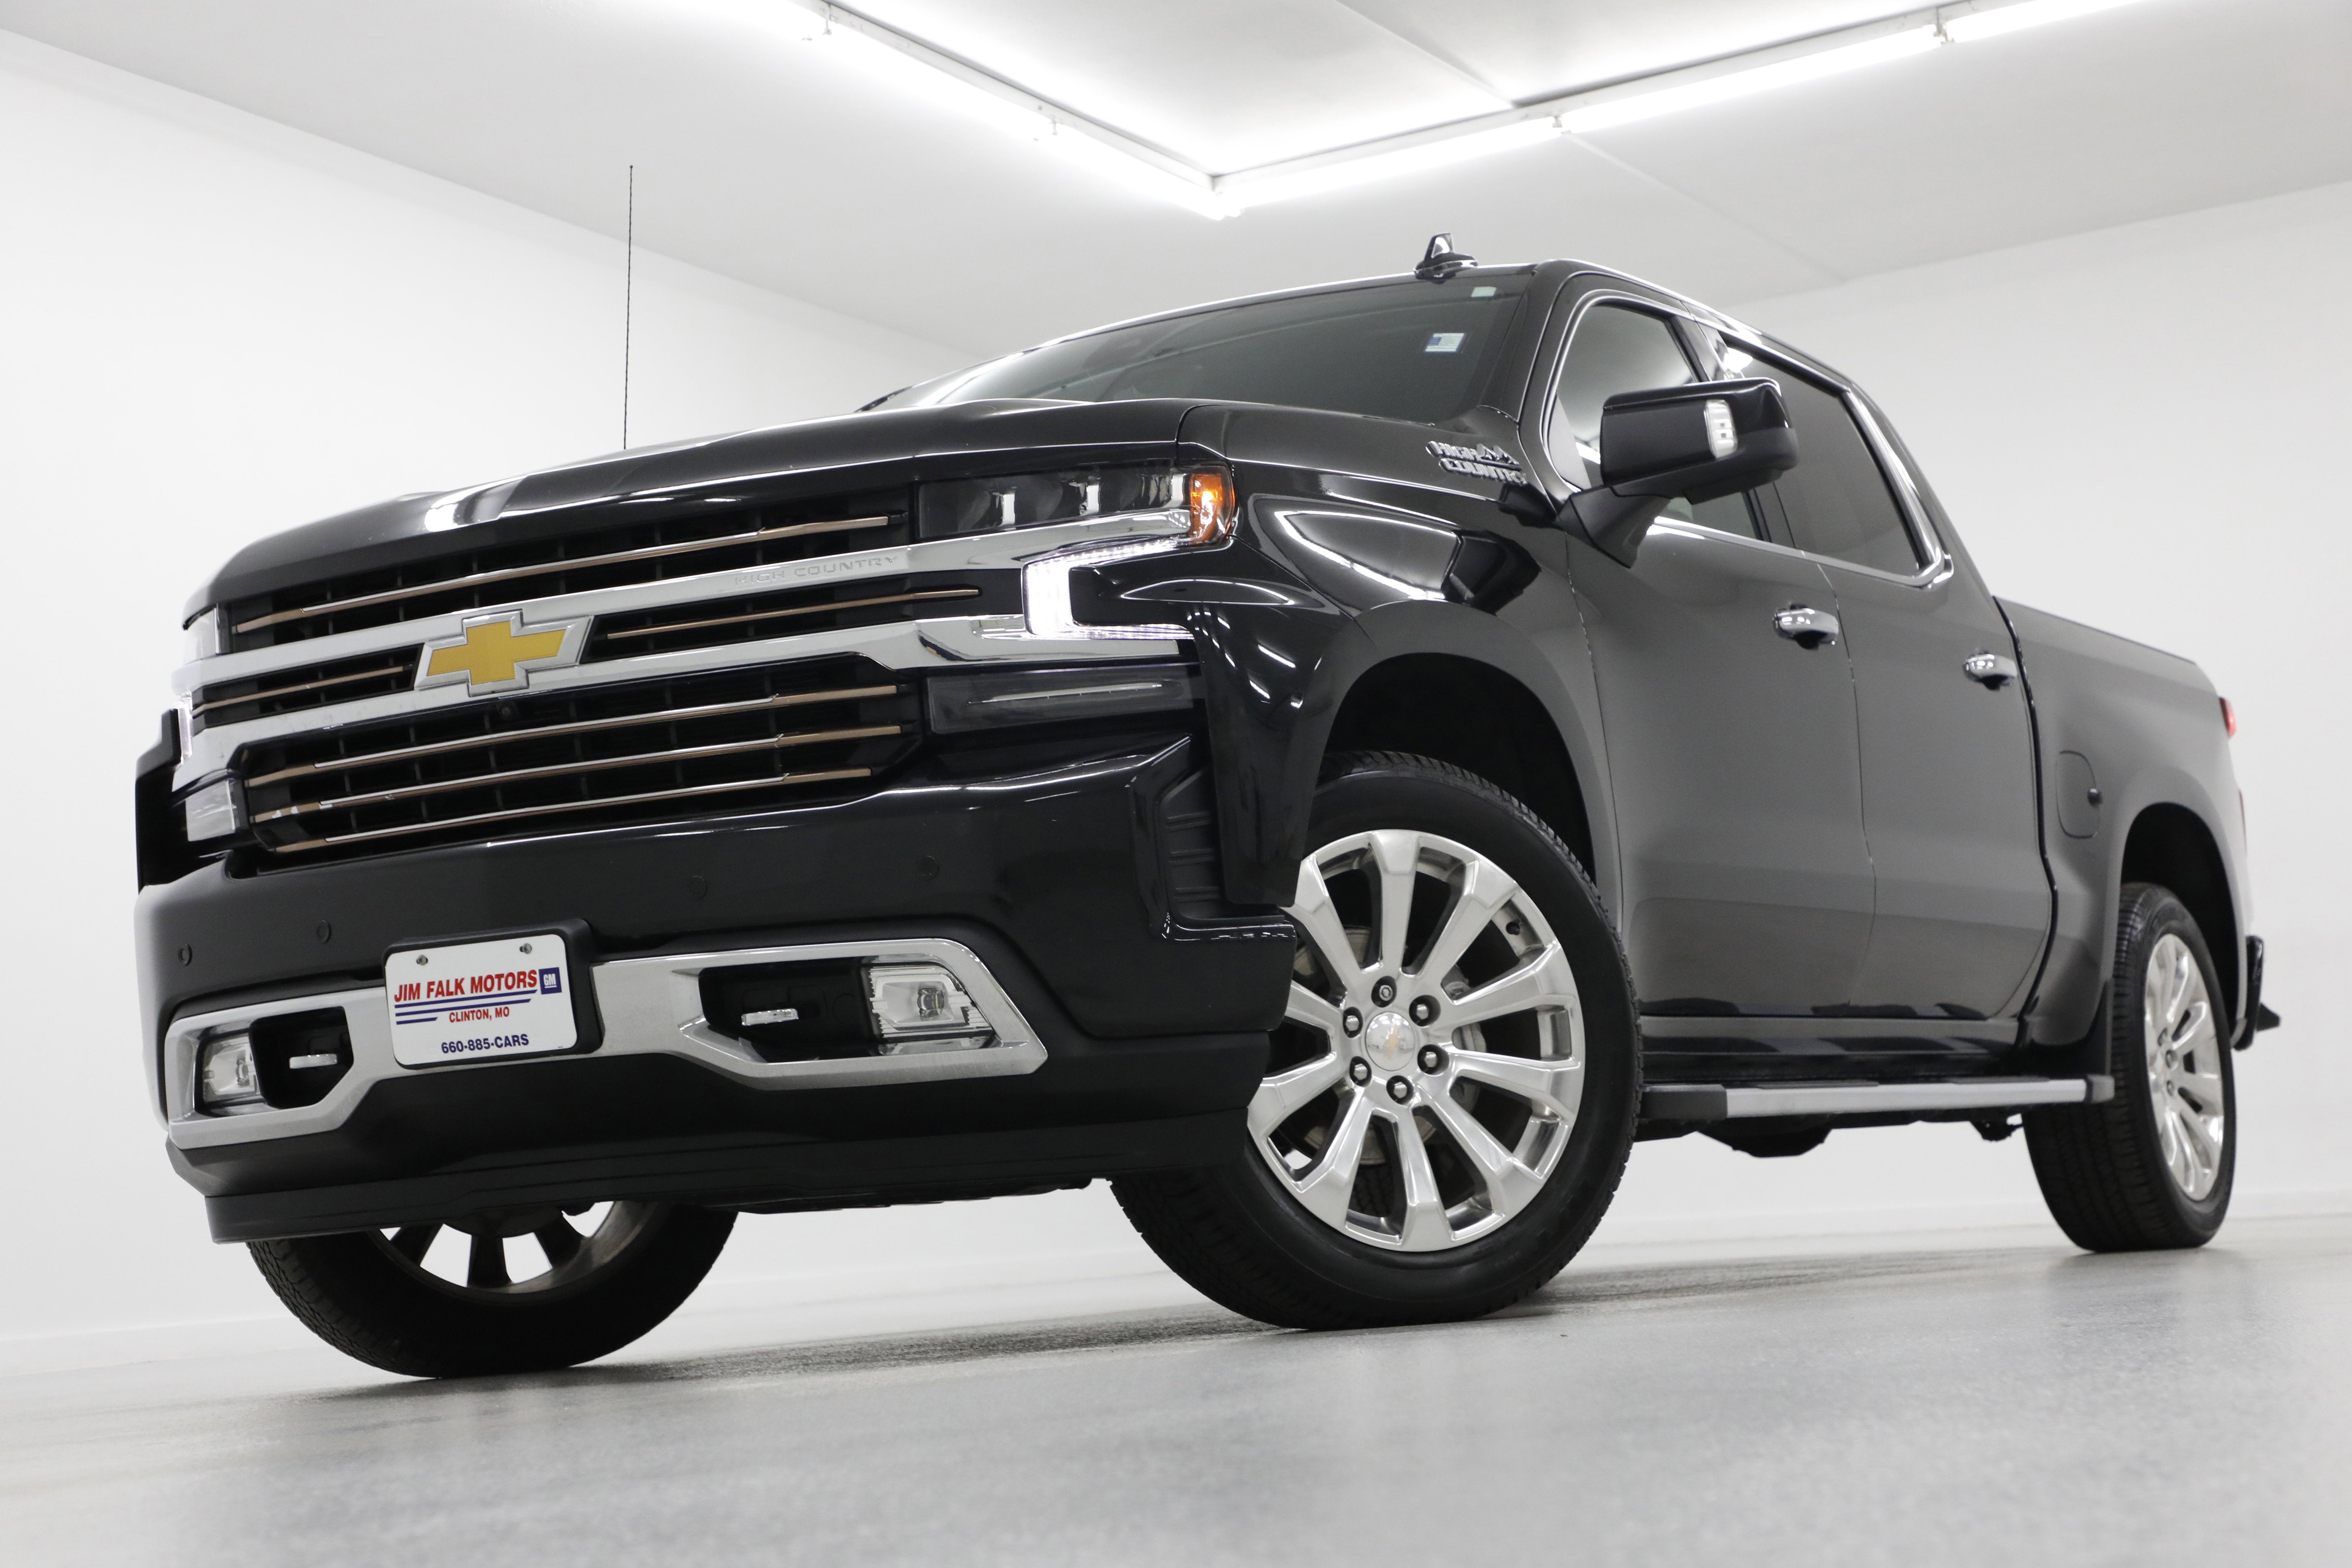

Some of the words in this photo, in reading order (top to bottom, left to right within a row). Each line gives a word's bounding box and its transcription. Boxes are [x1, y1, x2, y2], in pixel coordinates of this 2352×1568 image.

[1428, 441, 1481, 461] HIGH
[735, 570, 786, 586] HIGH
[794, 555, 898, 577] COUNTRY
[394, 983, 421, 1002] JIM
[426, 978, 465, 999] FALK
[470, 969, 537, 994] MOTORS
[543, 973, 557, 987] GM
[449, 1009, 492, 1023] CLINTON,
[495, 1007, 510, 1018] MO
[441, 1033, 529, 1054] 660-885-CARS
